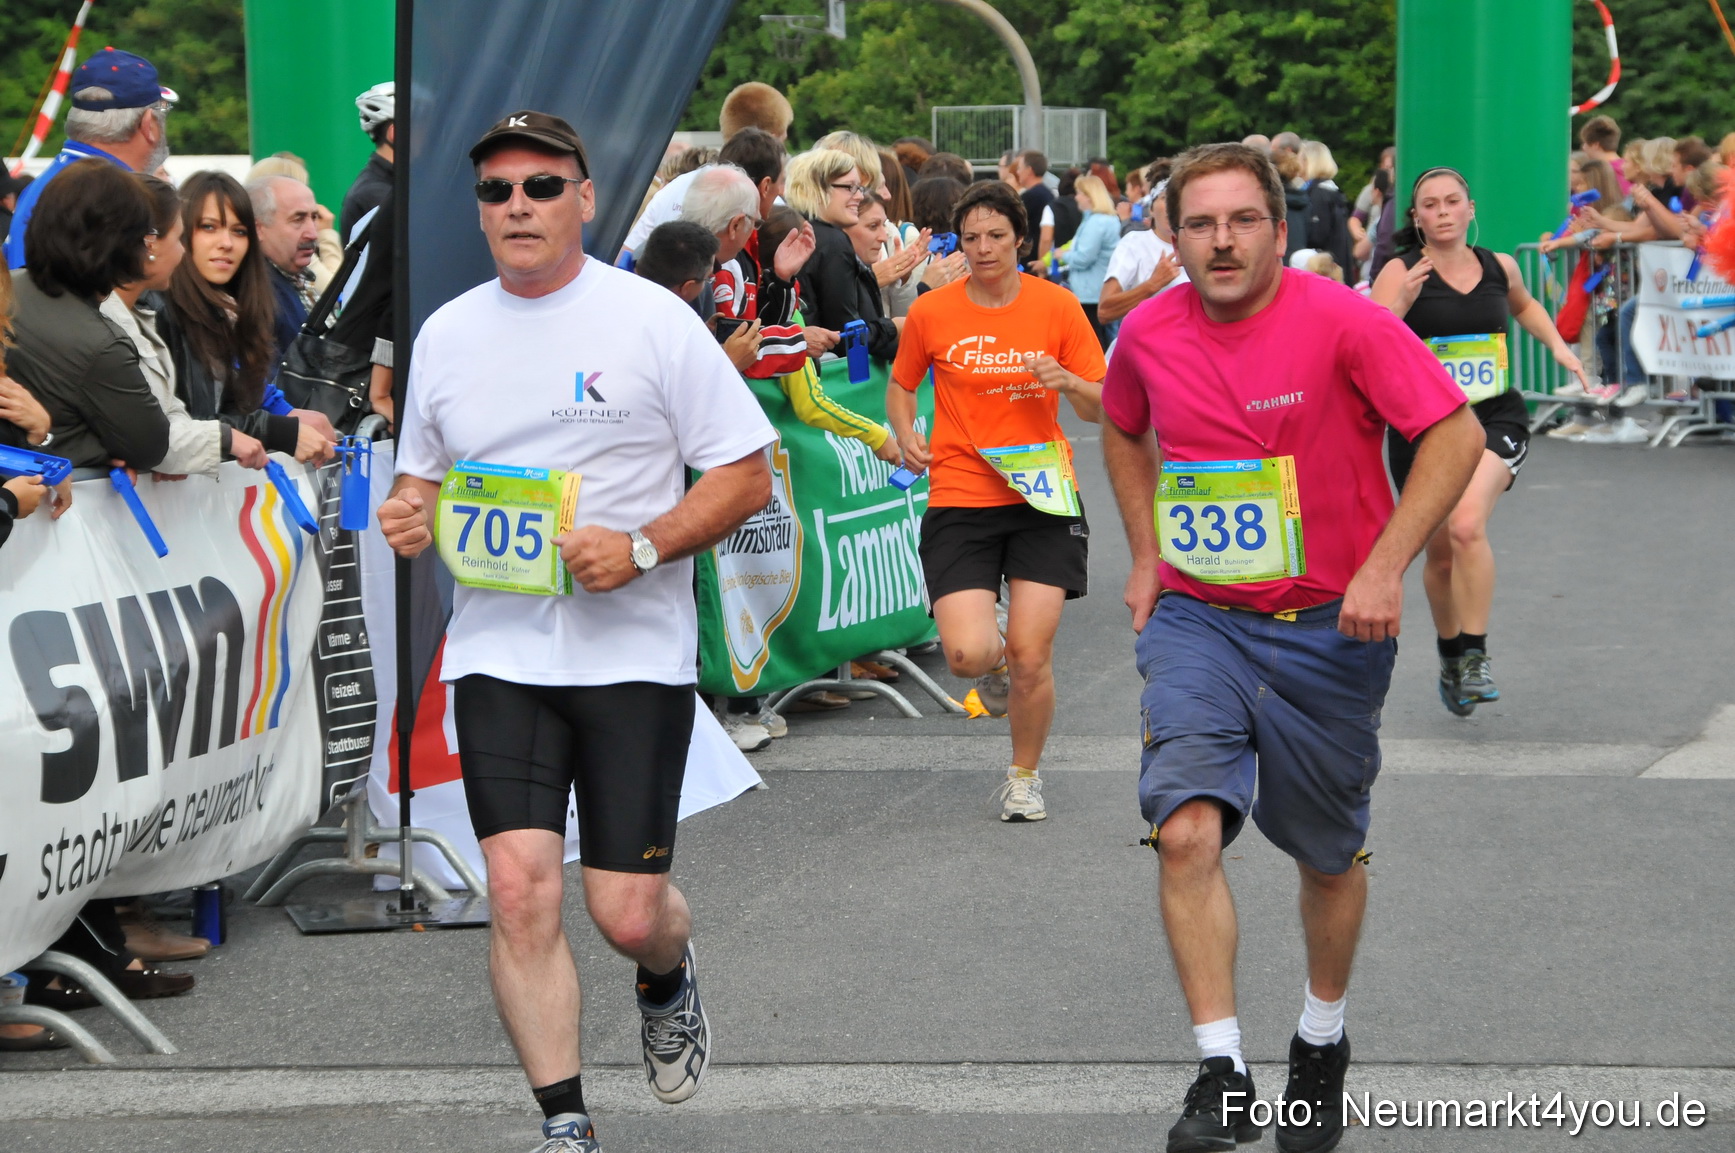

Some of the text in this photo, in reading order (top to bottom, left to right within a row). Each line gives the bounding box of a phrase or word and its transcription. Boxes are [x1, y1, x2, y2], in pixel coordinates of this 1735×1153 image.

[508, 114, 528, 127] K
[963, 348, 1044, 366] Fischer
[575, 372, 606, 402] K
[986, 385, 1003, 396] und
[1006, 383, 1022, 391] das
[1256, 391, 1303, 410] DAHMIT
[552, 407, 630, 418] KÜFNER
[457, 484, 498, 499] firmenlauf
[1011, 471, 1053, 498] 54
[1169, 486, 1211, 496] firmenlauf
[453, 505, 542, 561] 705
[1169, 503, 1267, 552] 338
[462, 556, 508, 572] Reinhold
[1186, 555, 1220, 565] Harald
[9, 575, 245, 804] swn
